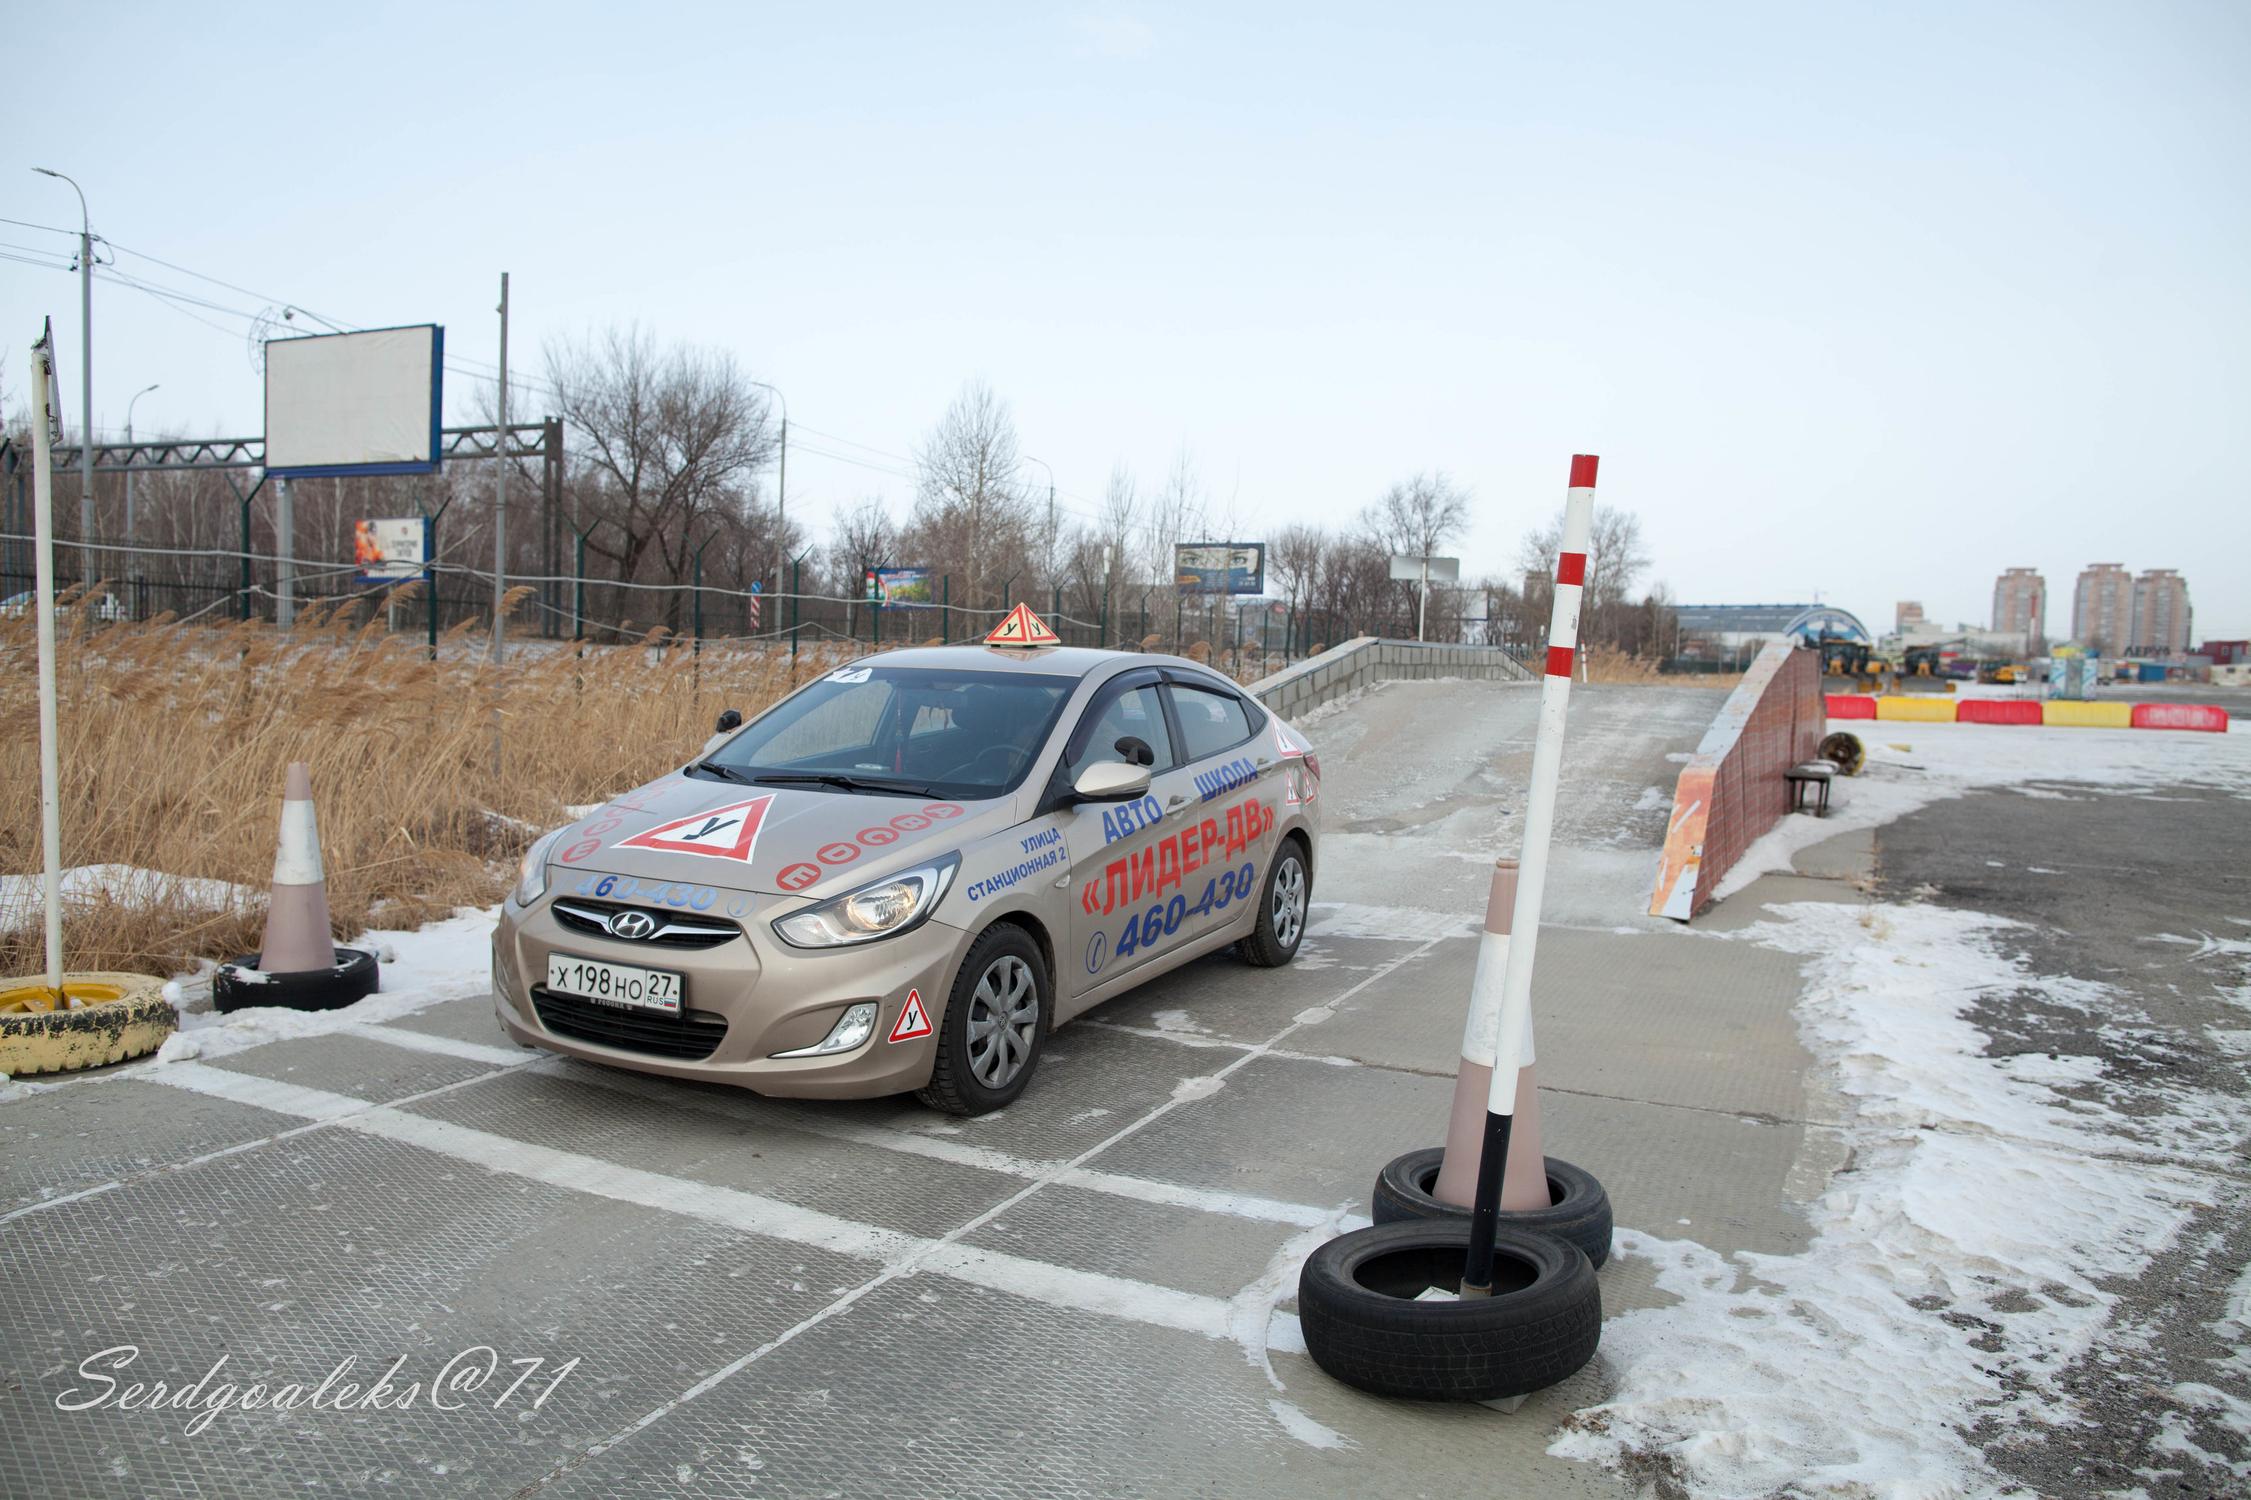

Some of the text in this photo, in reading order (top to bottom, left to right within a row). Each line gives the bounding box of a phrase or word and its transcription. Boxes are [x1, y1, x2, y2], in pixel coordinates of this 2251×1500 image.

[1003, 623, 1018, 636] У
[1031, 622, 1041, 635] У
[1102, 757, 1258, 844] АВТО ШКОЛА
[682, 817, 741, 840] У
[1020, 827, 1061, 855] УЛИЦА
[1081, 798, 1275, 917] «ЛИДЕР-ДВ»
[967, 846, 1067, 901] СТАНЦИОННАЯ 2
[1115, 862, 1254, 958] 460-430
[649, 974, 672, 996] 27
[647, 996, 664, 1005] RUS
[907, 1010, 918, 1030] У
